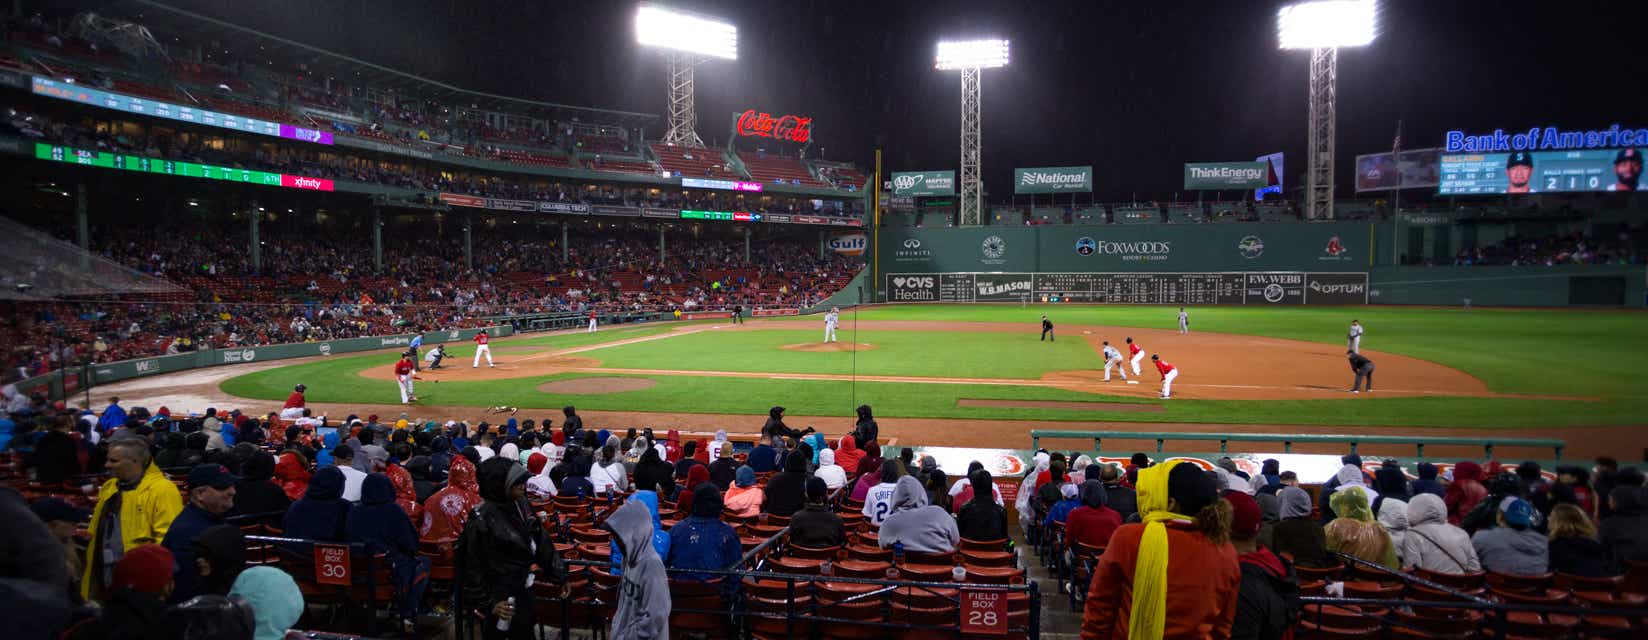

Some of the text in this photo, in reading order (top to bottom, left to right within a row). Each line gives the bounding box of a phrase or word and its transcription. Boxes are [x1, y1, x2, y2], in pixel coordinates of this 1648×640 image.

[1446, 124, 1648, 152] Bank of America
[1036, 172, 1086, 183] National
[1190, 167, 1261, 179] ThinkEnergy
[295, 177, 321, 190] xfinity
[1547, 177, 1556, 189] 2
[1570, 177, 1575, 188] 1
[1589, 176, 1599, 188] 0
[831, 239, 865, 248] Gulf
[1098, 240, 1169, 254] FOXWOODS
[906, 277, 934, 288] CVS
[1269, 275, 1301, 283] WEBB
[895, 289, 934, 300] Health
[1322, 284, 1363, 294] OPTUM
[322, 547, 344, 556] FIELD
[323, 563, 346, 578] 30
[968, 592, 999, 600] FIELD
[972, 600, 994, 608] BOX
[969, 611, 998, 626] 28
